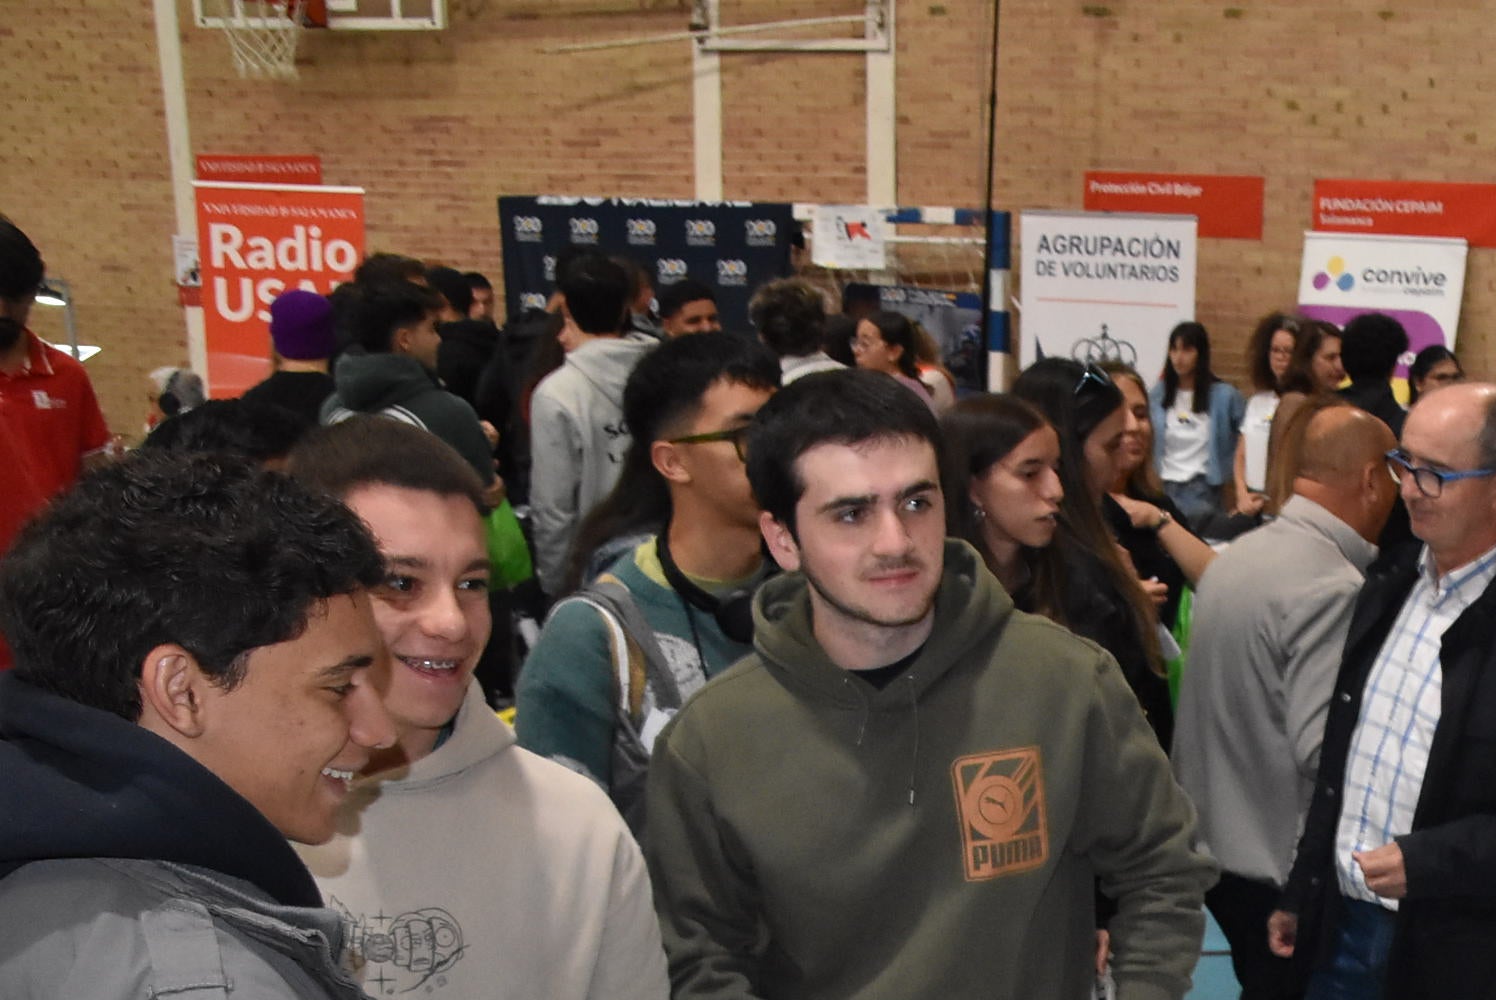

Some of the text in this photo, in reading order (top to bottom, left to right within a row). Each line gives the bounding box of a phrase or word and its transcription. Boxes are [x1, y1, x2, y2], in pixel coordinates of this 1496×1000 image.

[1090, 181, 1147, 194] Protección
[1148, 183, 1173, 195] Civil
[1320, 197, 1443, 214] FUNDACIÓN CEPAIM
[1320, 214, 1373, 226] Salamanca
[209, 223, 357, 273] Radio
[1037, 234, 1180, 260] AGRUPACIÓN
[1036, 260, 1180, 284] DE VOLUNTARIOS
[1363, 267, 1447, 286] convive
[972, 834, 1042, 871] PUMA
